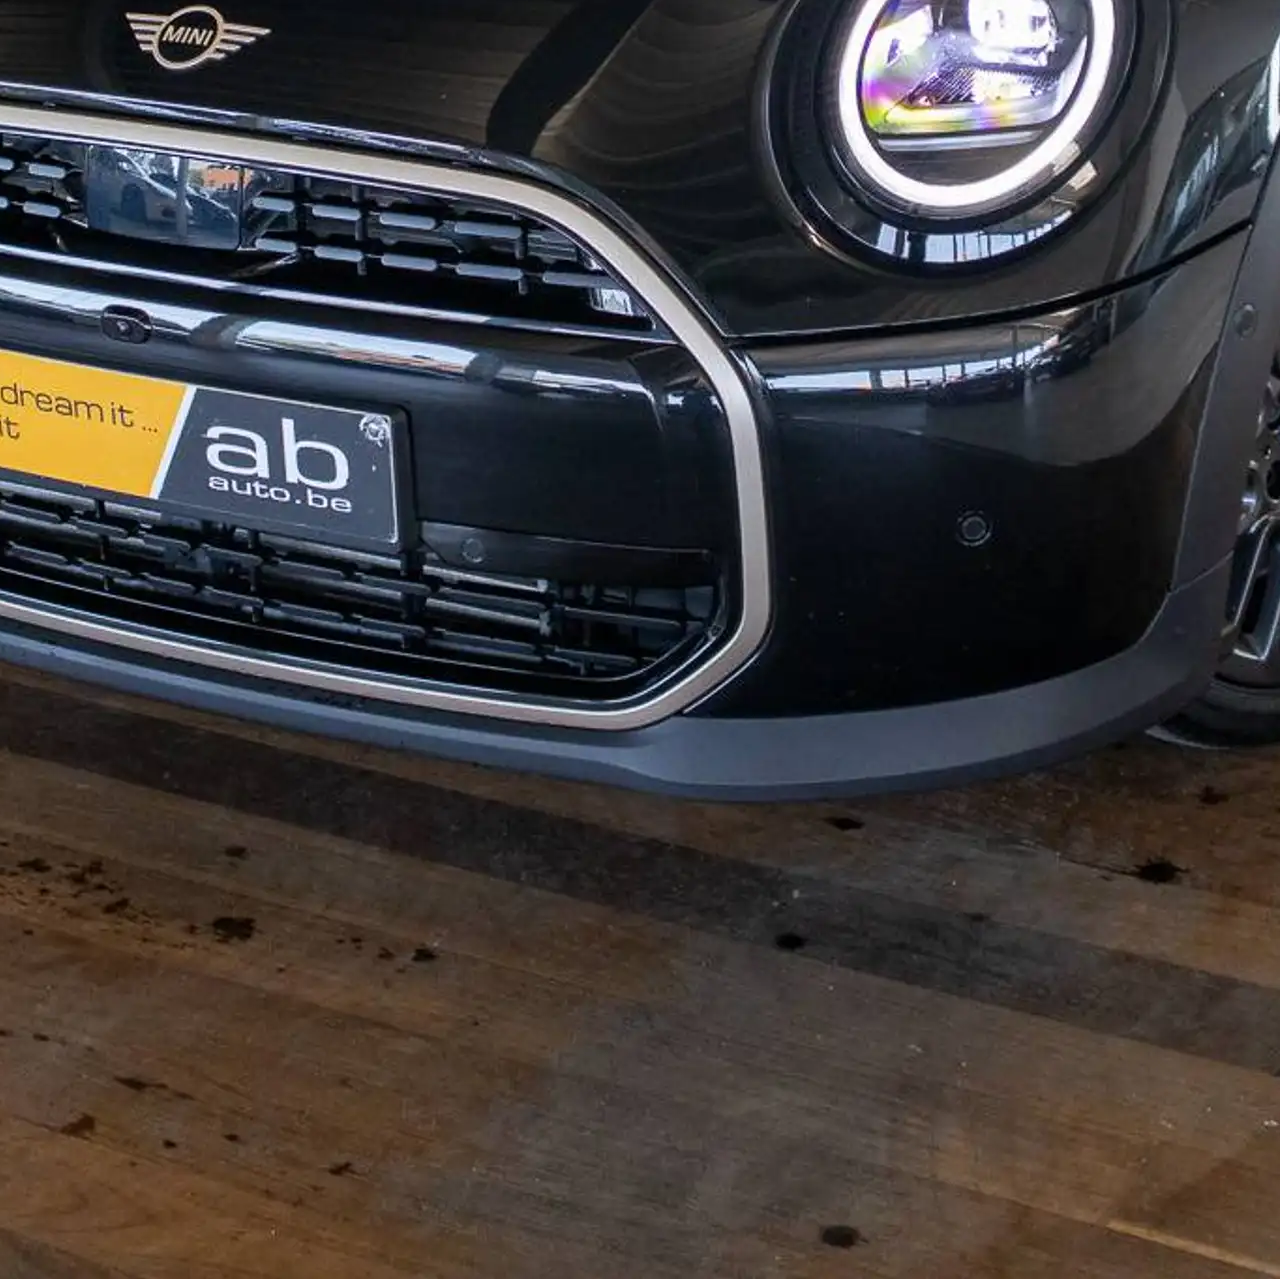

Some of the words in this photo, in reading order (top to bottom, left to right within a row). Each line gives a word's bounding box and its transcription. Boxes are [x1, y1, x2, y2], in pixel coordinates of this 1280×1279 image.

[162, 24, 214, 47] MINI
[0, 382, 104, 422] dream
[111, 402, 134, 428] it
[205, 417, 349, 490] ab
[208, 476, 353, 513] auto.be
